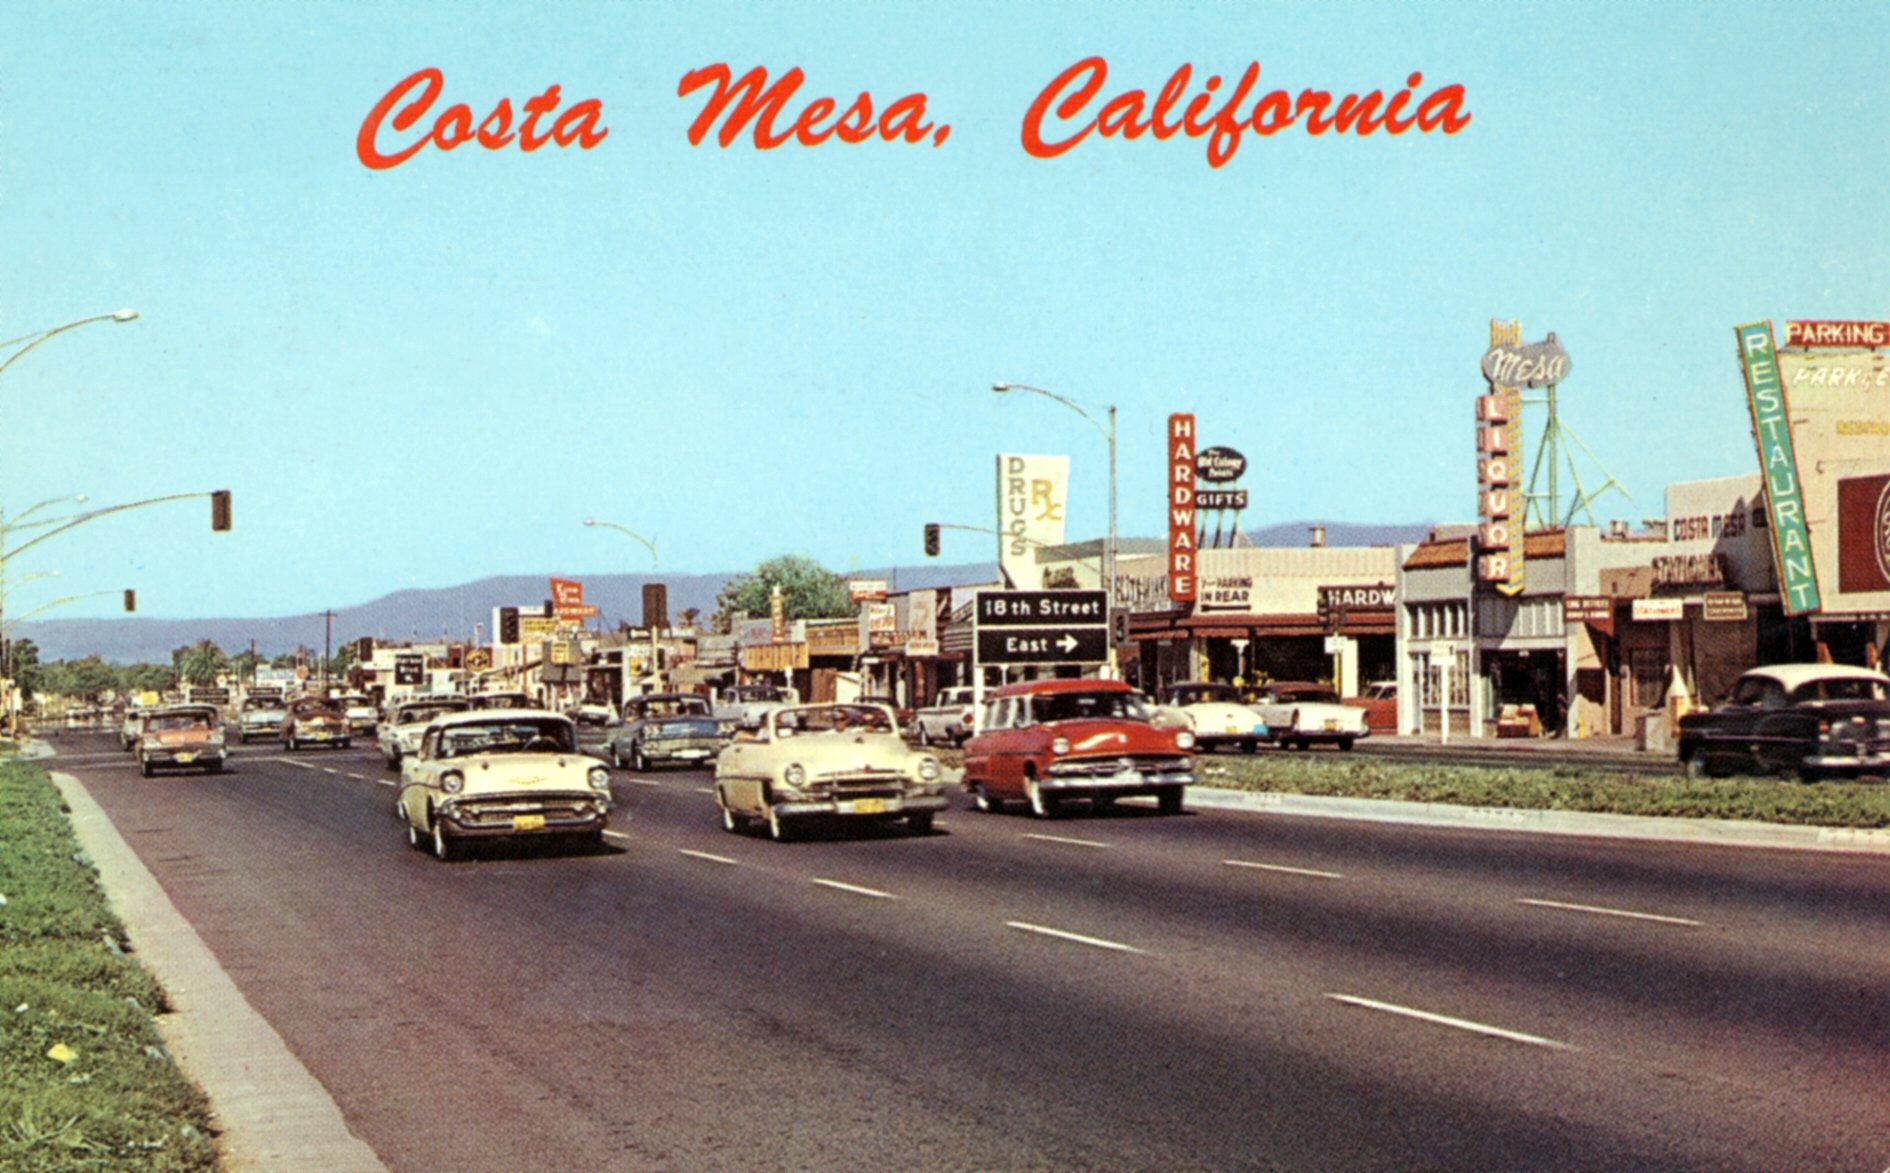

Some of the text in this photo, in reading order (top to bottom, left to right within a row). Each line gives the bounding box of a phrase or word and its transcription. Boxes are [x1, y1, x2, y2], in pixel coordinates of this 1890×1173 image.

[1786, 323, 1885, 344] PARKING
[1488, 348, 1565, 383] Mesa
[1792, 367, 1862, 386] PARK
[1745, 332, 1813, 610] RESTAURANT
[1486, 398, 1508, 572] LIQUOR
[1008, 456, 1027, 556] DRUGS
[1173, 420, 1194, 594] HARDWARE
[1196, 492, 1245, 506] GIFTS
[1674, 513, 1746, 542] COSTA MESA
[1217, 576, 1253, 588] PARKING
[985, 598, 1099, 616] 18th Street
[1200, 590, 1250, 603] IN REAR
[1006, 636, 1048, 653] East
